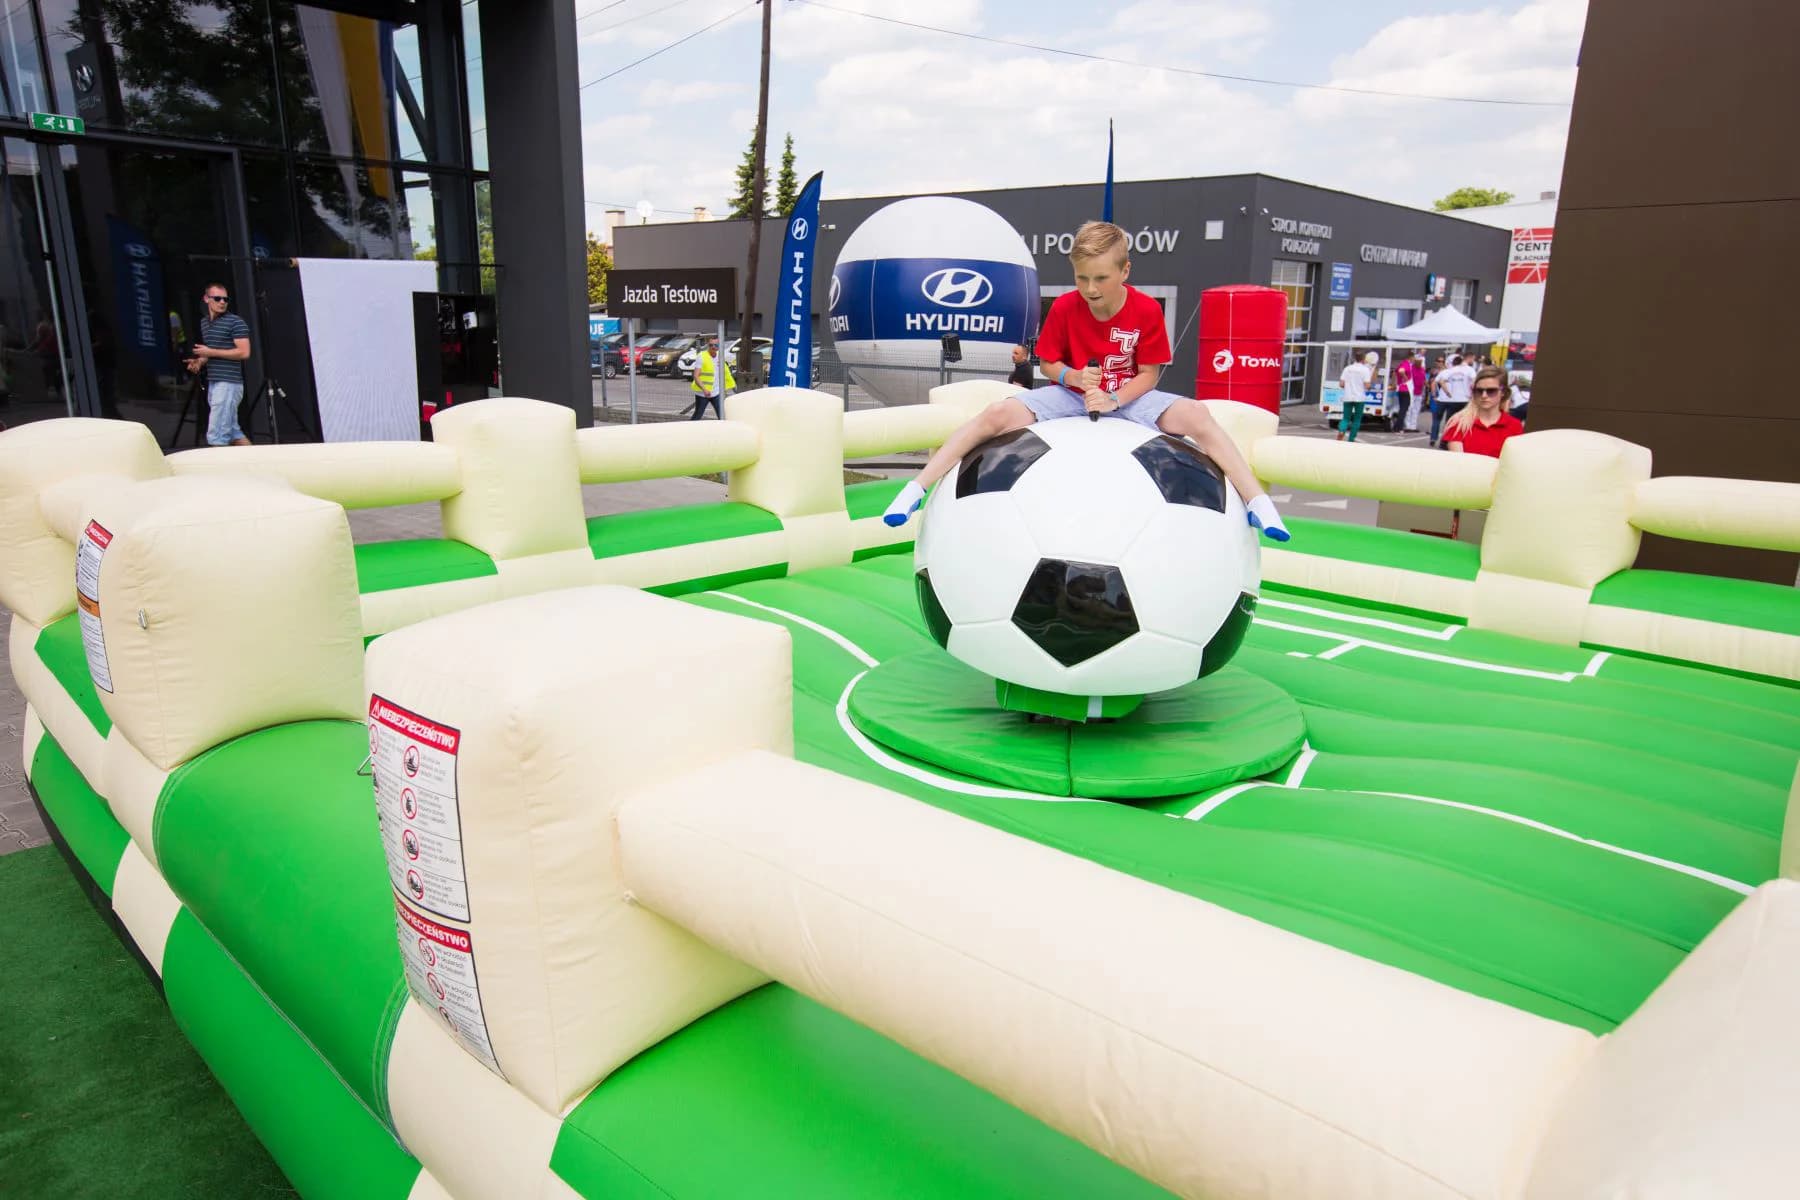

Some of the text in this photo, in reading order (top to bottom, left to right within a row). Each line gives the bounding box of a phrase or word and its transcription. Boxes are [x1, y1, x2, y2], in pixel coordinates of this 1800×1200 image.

[622, 284, 717, 303] Jazda Testowa
[783, 251, 804, 388] HYUNDA
[906, 313, 1004, 333] HYUNDAI
